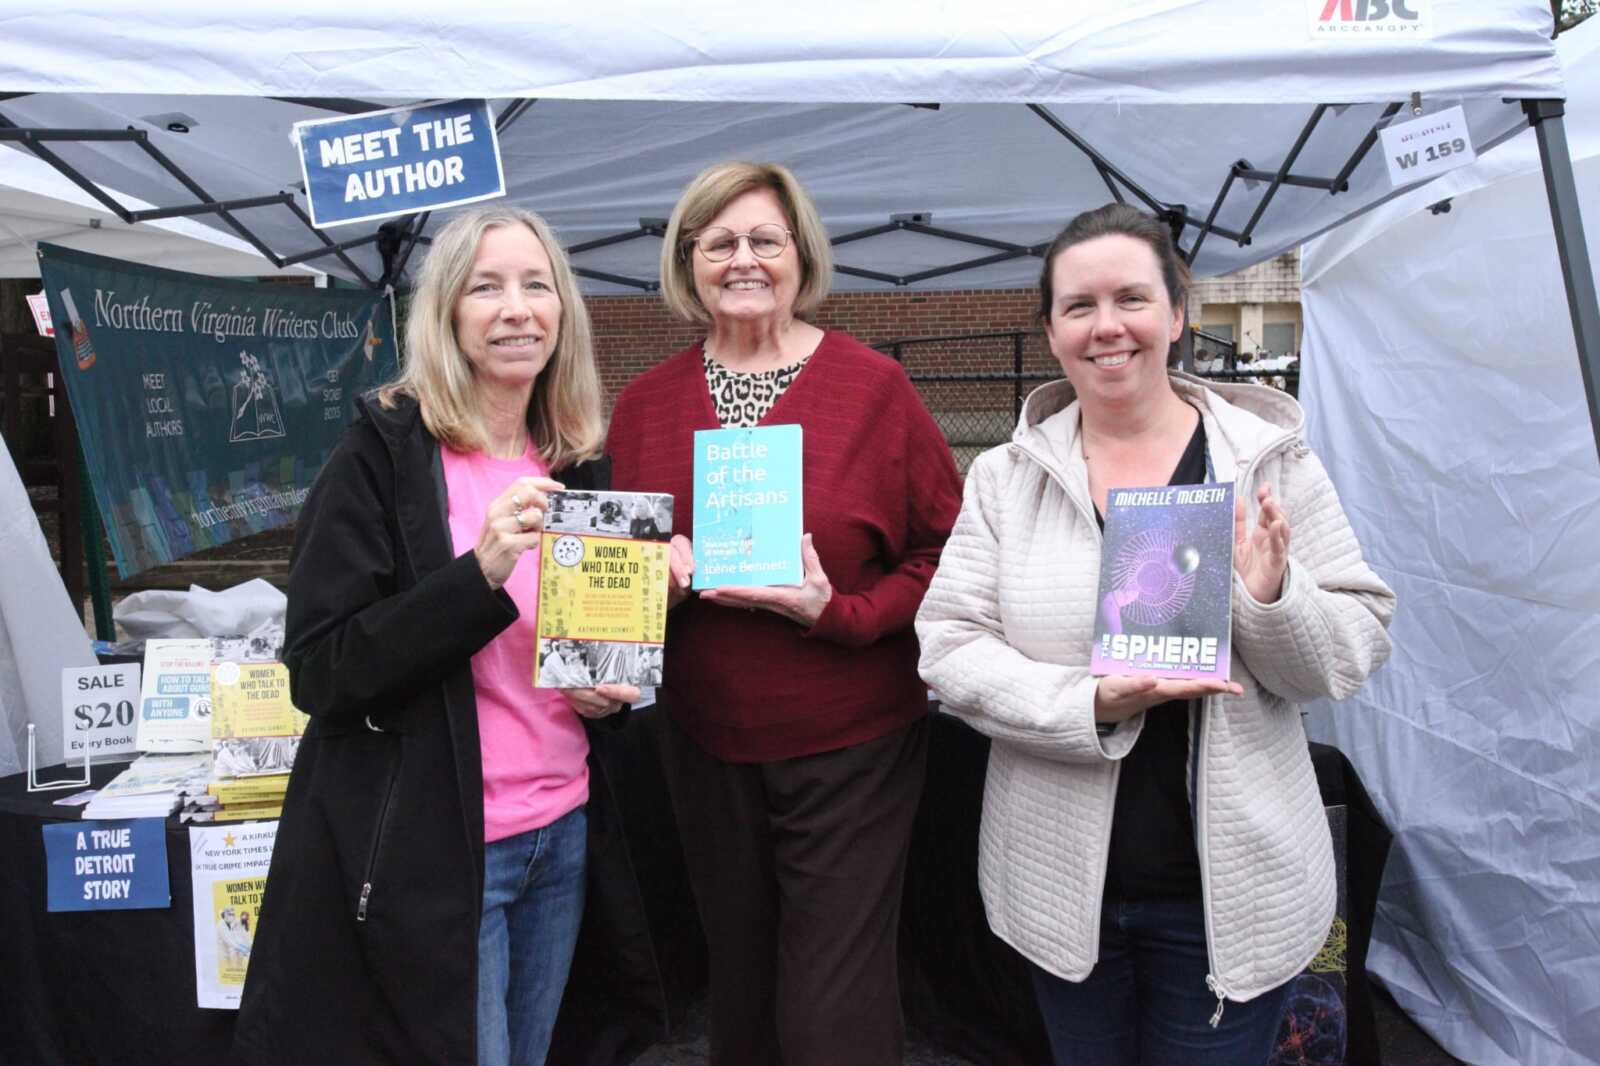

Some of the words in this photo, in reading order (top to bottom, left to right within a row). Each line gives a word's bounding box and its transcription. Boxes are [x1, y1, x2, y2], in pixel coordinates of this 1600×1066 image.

[319, 127, 402, 168] MEET
[412, 114, 474, 152] THE
[1395, 151, 1418, 170] W
[1425, 138, 1466, 162] 159
[344, 155, 465, 202] AUTHOR
[94, 289, 184, 332] Northern
[190, 301, 256, 343] Virginia
[262, 307, 318, 339] Writers
[320, 311, 359, 339] Club
[706, 441, 768, 461] Battle
[706, 465, 728, 486] of
[734, 464, 768, 484] the
[705, 489, 788, 508] Artisans
[1114, 492, 1173, 506] MICHELLE
[1176, 488, 1226, 504] MCBETH
[594, 546, 628, 558] WOMEN
[582, 561, 602, 573] WHO
[604, 561, 624, 573] TALK
[628, 562, 639, 574] TO
[589, 576, 606, 588] THE
[607, 577, 631, 589] DEAD
[1111, 634, 1218, 664] SPHERE
[77, 674, 124, 690] SALE
[249, 669, 276, 679] WOMEN
[240, 680, 256, 690] WHO
[258, 679, 274, 689] TALK
[276, 679, 285, 688] TO
[247, 690, 260, 700] THE
[261, 690, 280, 699] DEAD
[74, 700, 134, 730] $20
[71, 740, 103, 750] Evry
[104, 736, 133, 746] Book
[76, 831, 87, 850] A
[91, 828, 131, 849] TRUE
[222, 848, 242, 856] YORK
[244, 846, 268, 854] TIMES
[74, 853, 135, 875] DETROIT
[203, 863, 217, 871] TRUE
[219, 862, 242, 870] CRIME
[83, 879, 131, 899] STORY
[226, 881, 254, 893] WOMEN
[231, 895, 247, 904] TALK
[249, 894, 258, 904] TO
